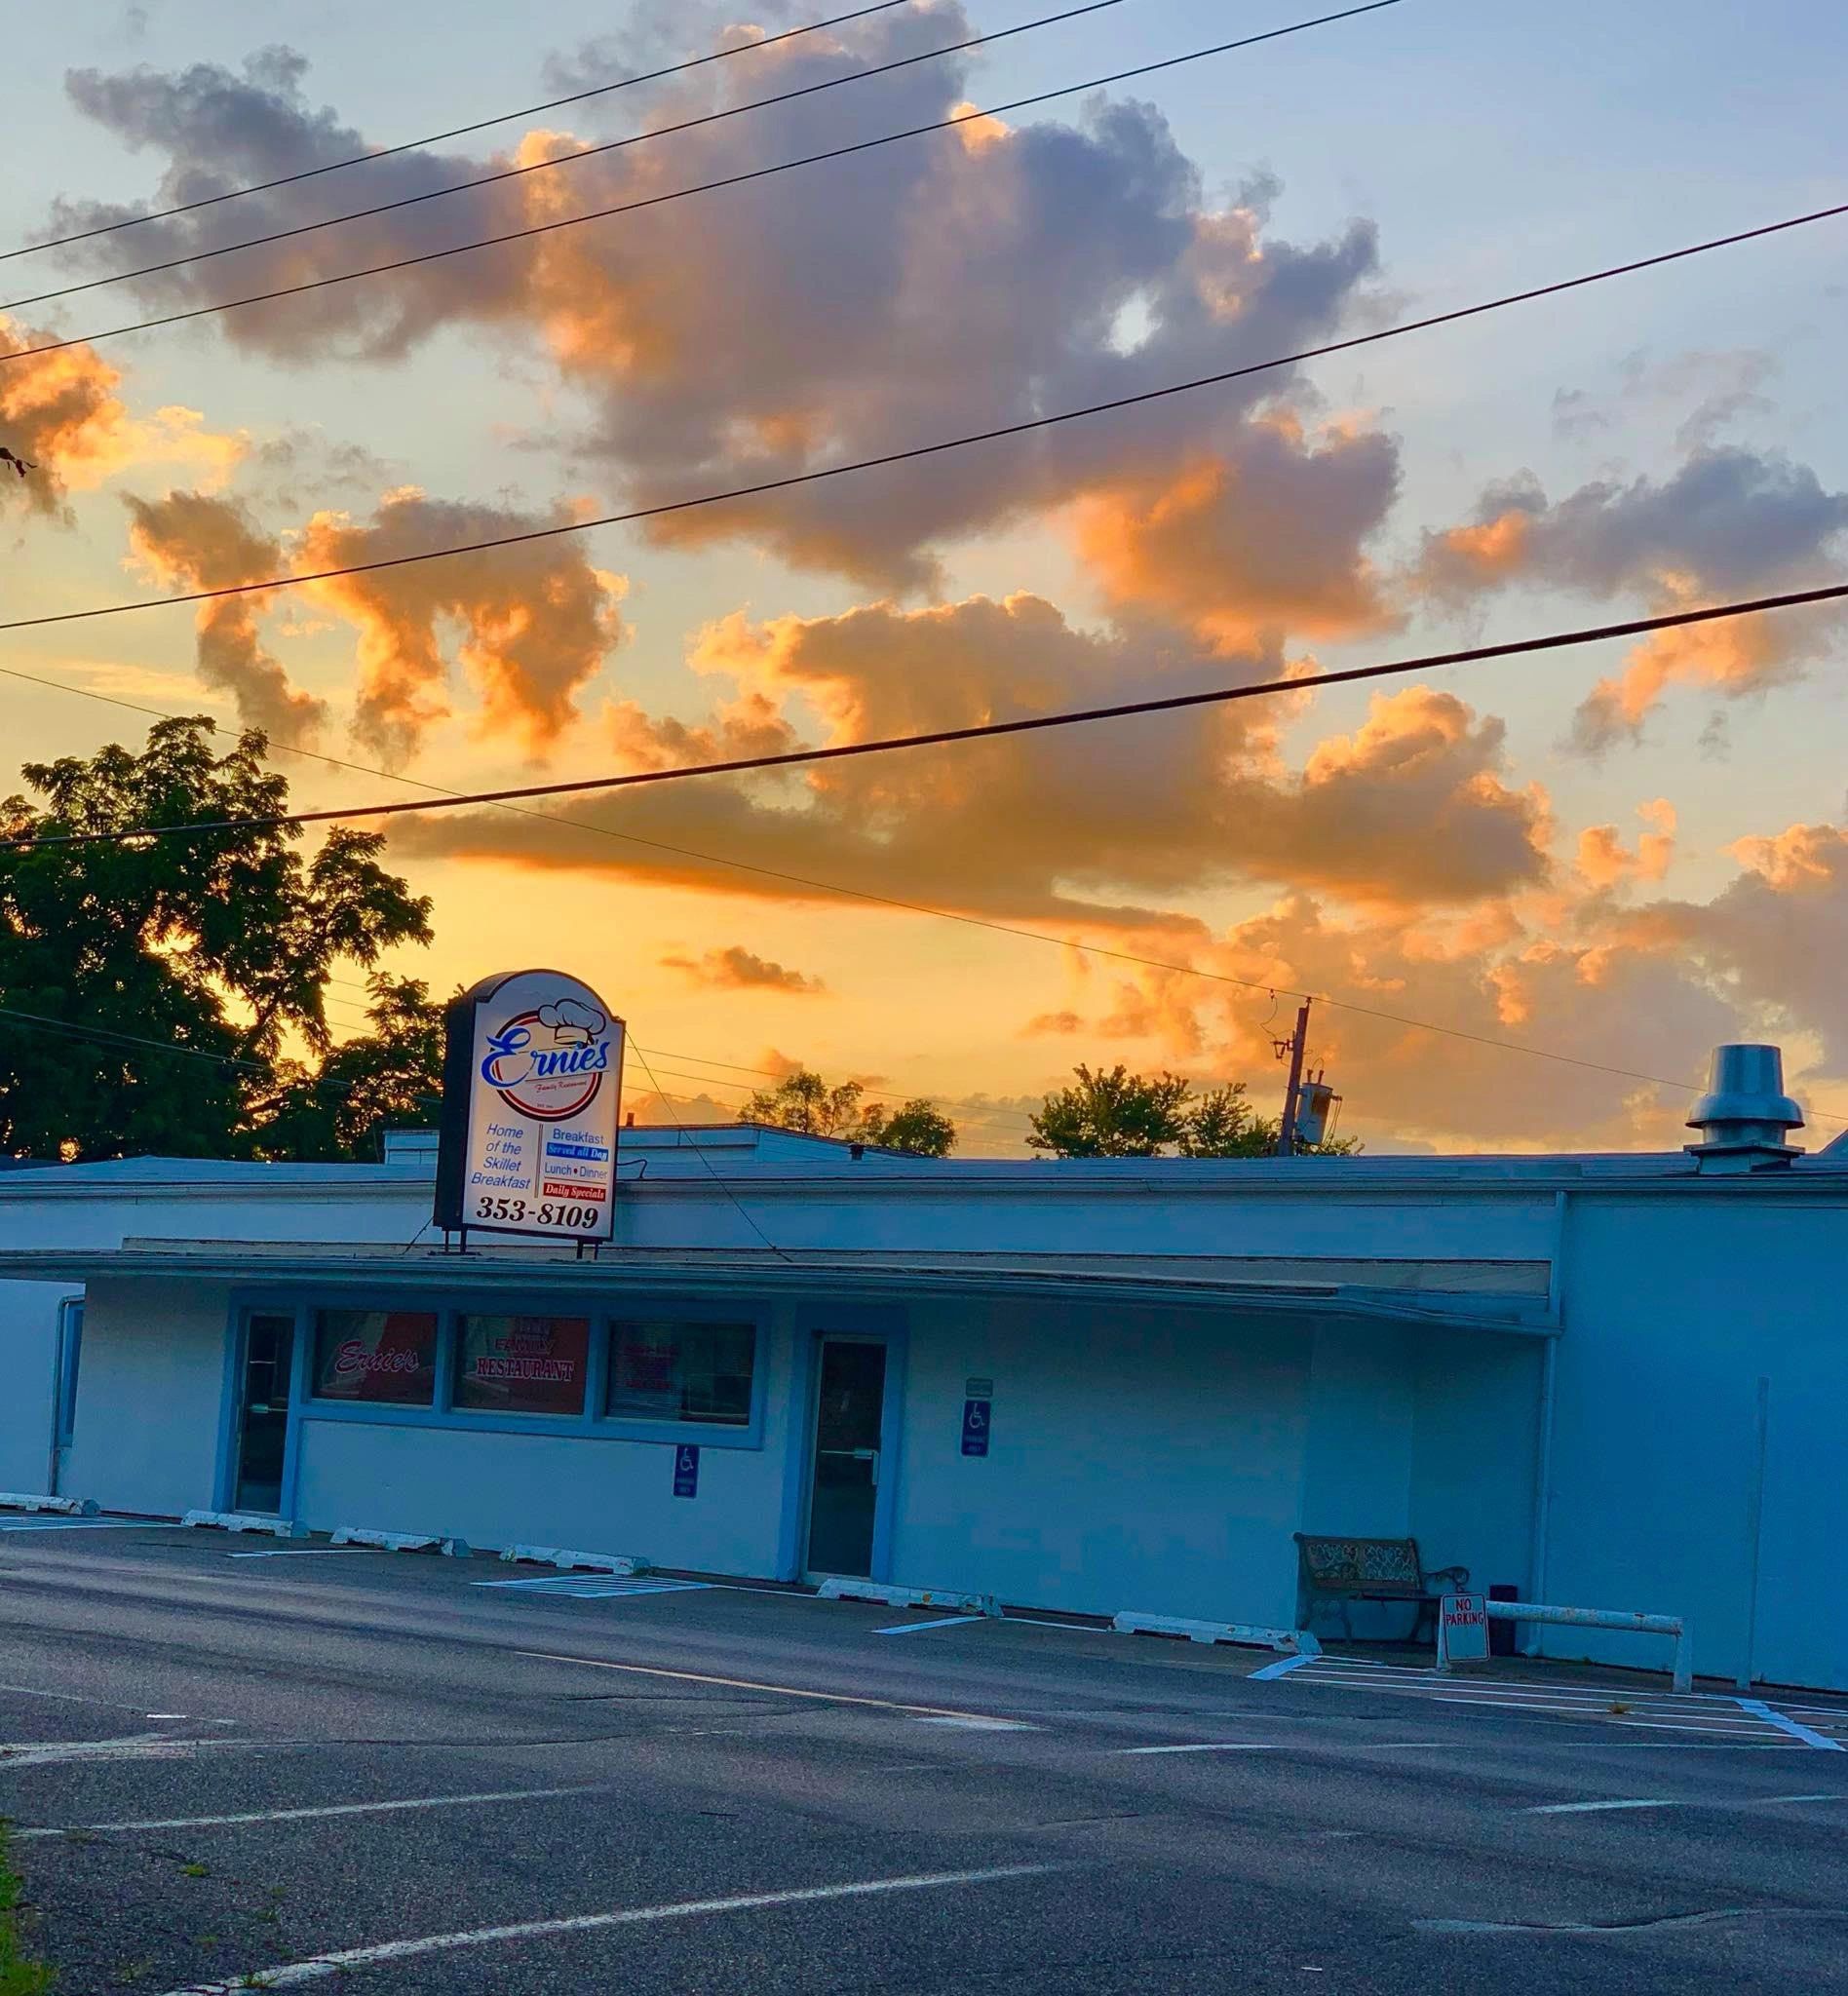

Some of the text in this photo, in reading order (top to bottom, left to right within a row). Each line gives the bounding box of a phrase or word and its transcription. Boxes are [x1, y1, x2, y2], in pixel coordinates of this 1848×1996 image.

[487, 1123, 523, 1139] Home
[553, 1129, 604, 1145] Breakfast
[485, 1140, 521, 1155] of the
[548, 1144, 608, 1161] Served all Day
[483, 1157, 521, 1172] Skillet
[544, 1163, 608, 1179] Lunch Dinner
[472, 1171, 530, 1190] Breakfast
[545, 1184, 604, 1200] Daily Specials
[477, 1196, 598, 1230] 353-8109
[494, 1338, 557, 1356] FAMILY
[334, 1339, 419, 1374] Ernie's
[476, 1357, 575, 1382] RESTAURANT
[1455, 1597, 1472, 1612] NO
[1445, 1612, 1484, 1626] PARKING
